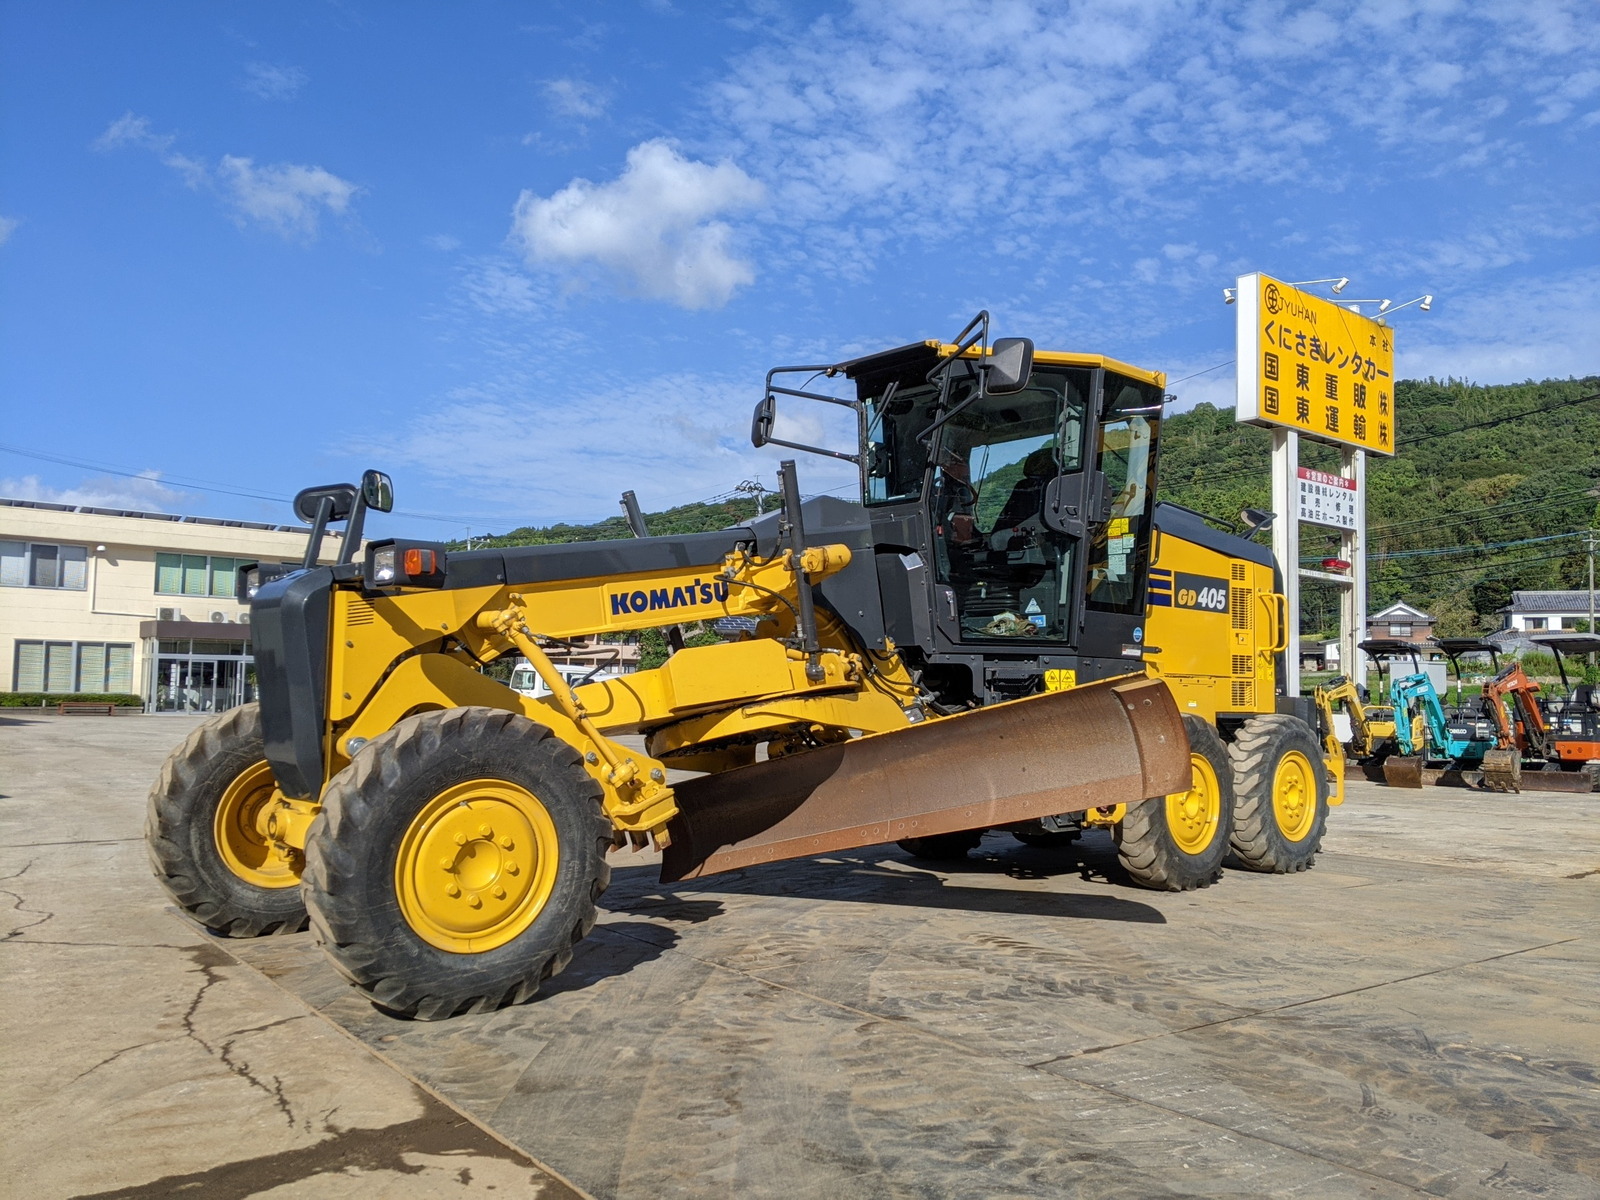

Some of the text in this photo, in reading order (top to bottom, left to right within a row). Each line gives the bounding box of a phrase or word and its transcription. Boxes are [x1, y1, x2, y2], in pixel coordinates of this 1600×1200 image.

[1278, 297, 1317, 325] JYUHAN
[1264, 320, 1390, 381] くにさきレンタカー
[610, 578, 729, 615] KOMATSU
